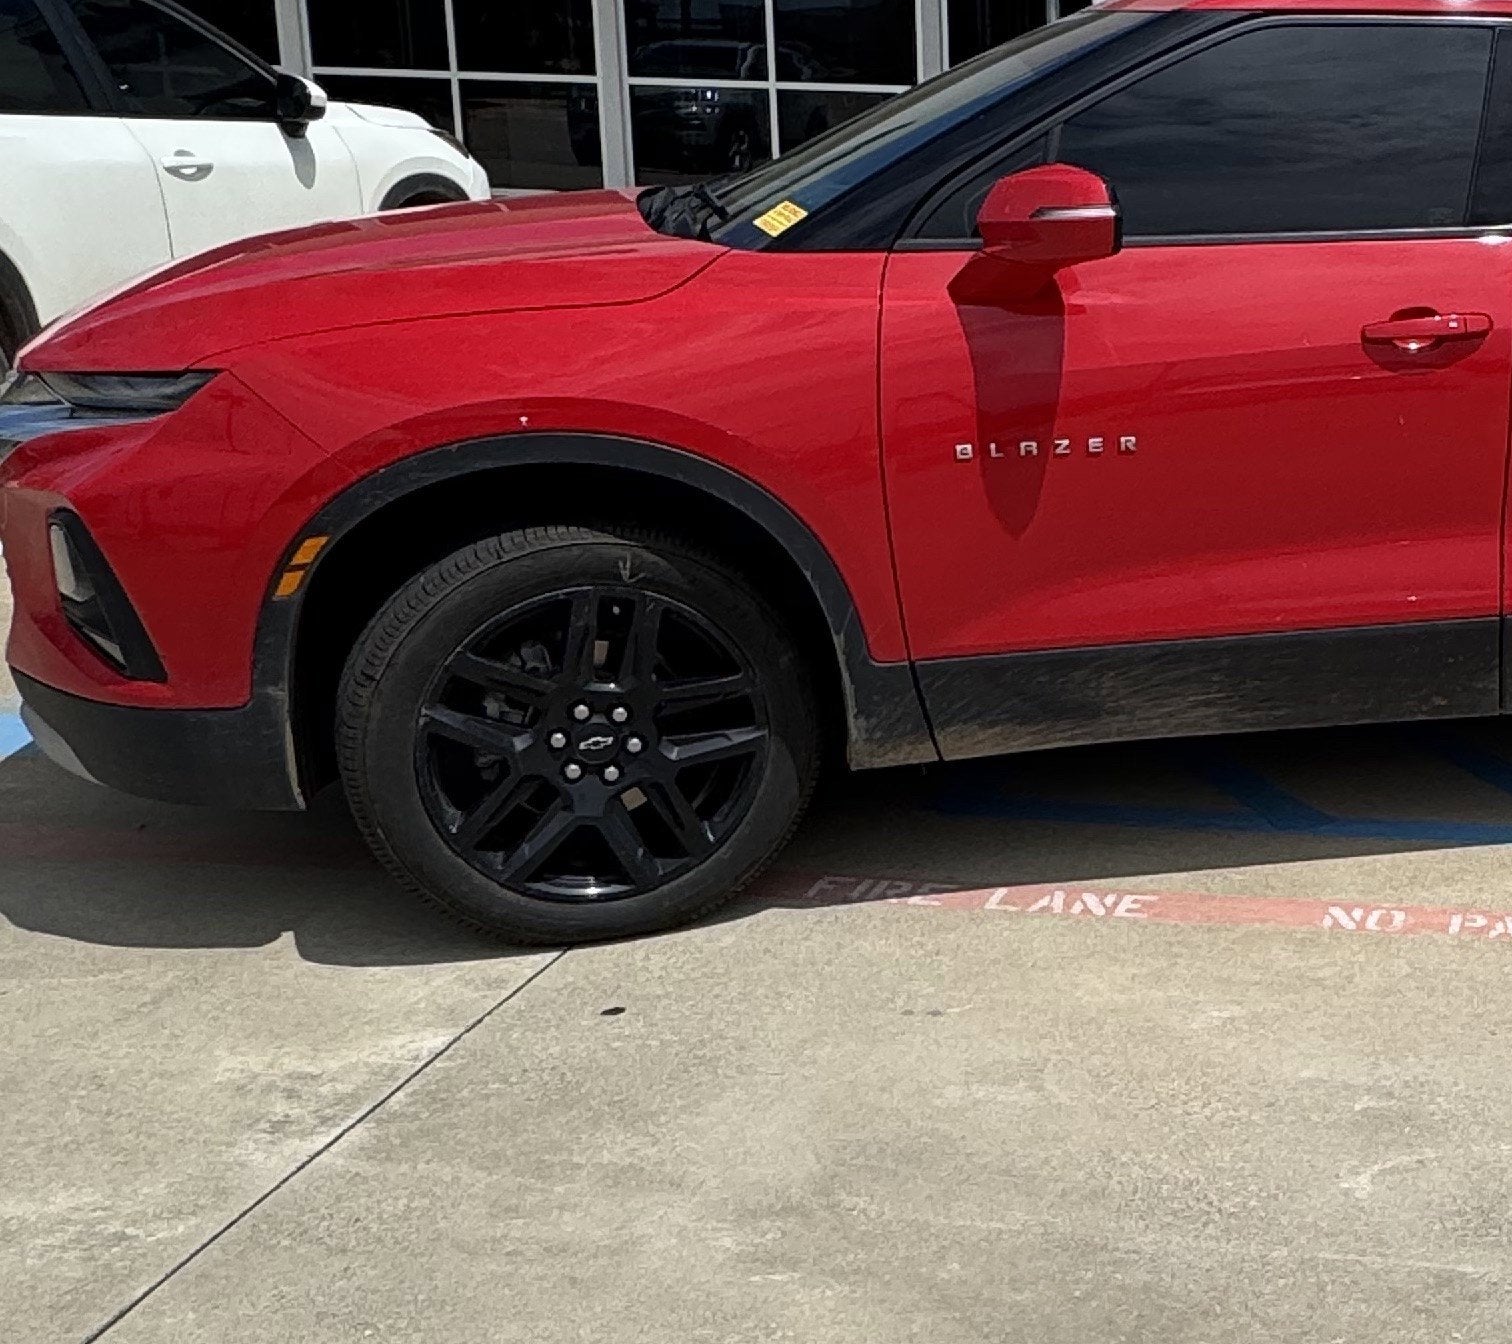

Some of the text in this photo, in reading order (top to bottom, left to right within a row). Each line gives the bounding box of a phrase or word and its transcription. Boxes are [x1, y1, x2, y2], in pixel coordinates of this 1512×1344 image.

[954, 435, 1137, 461] BLAZER
[983, 887, 1160, 918] LANE
[1322, 906, 1406, 931] NO
